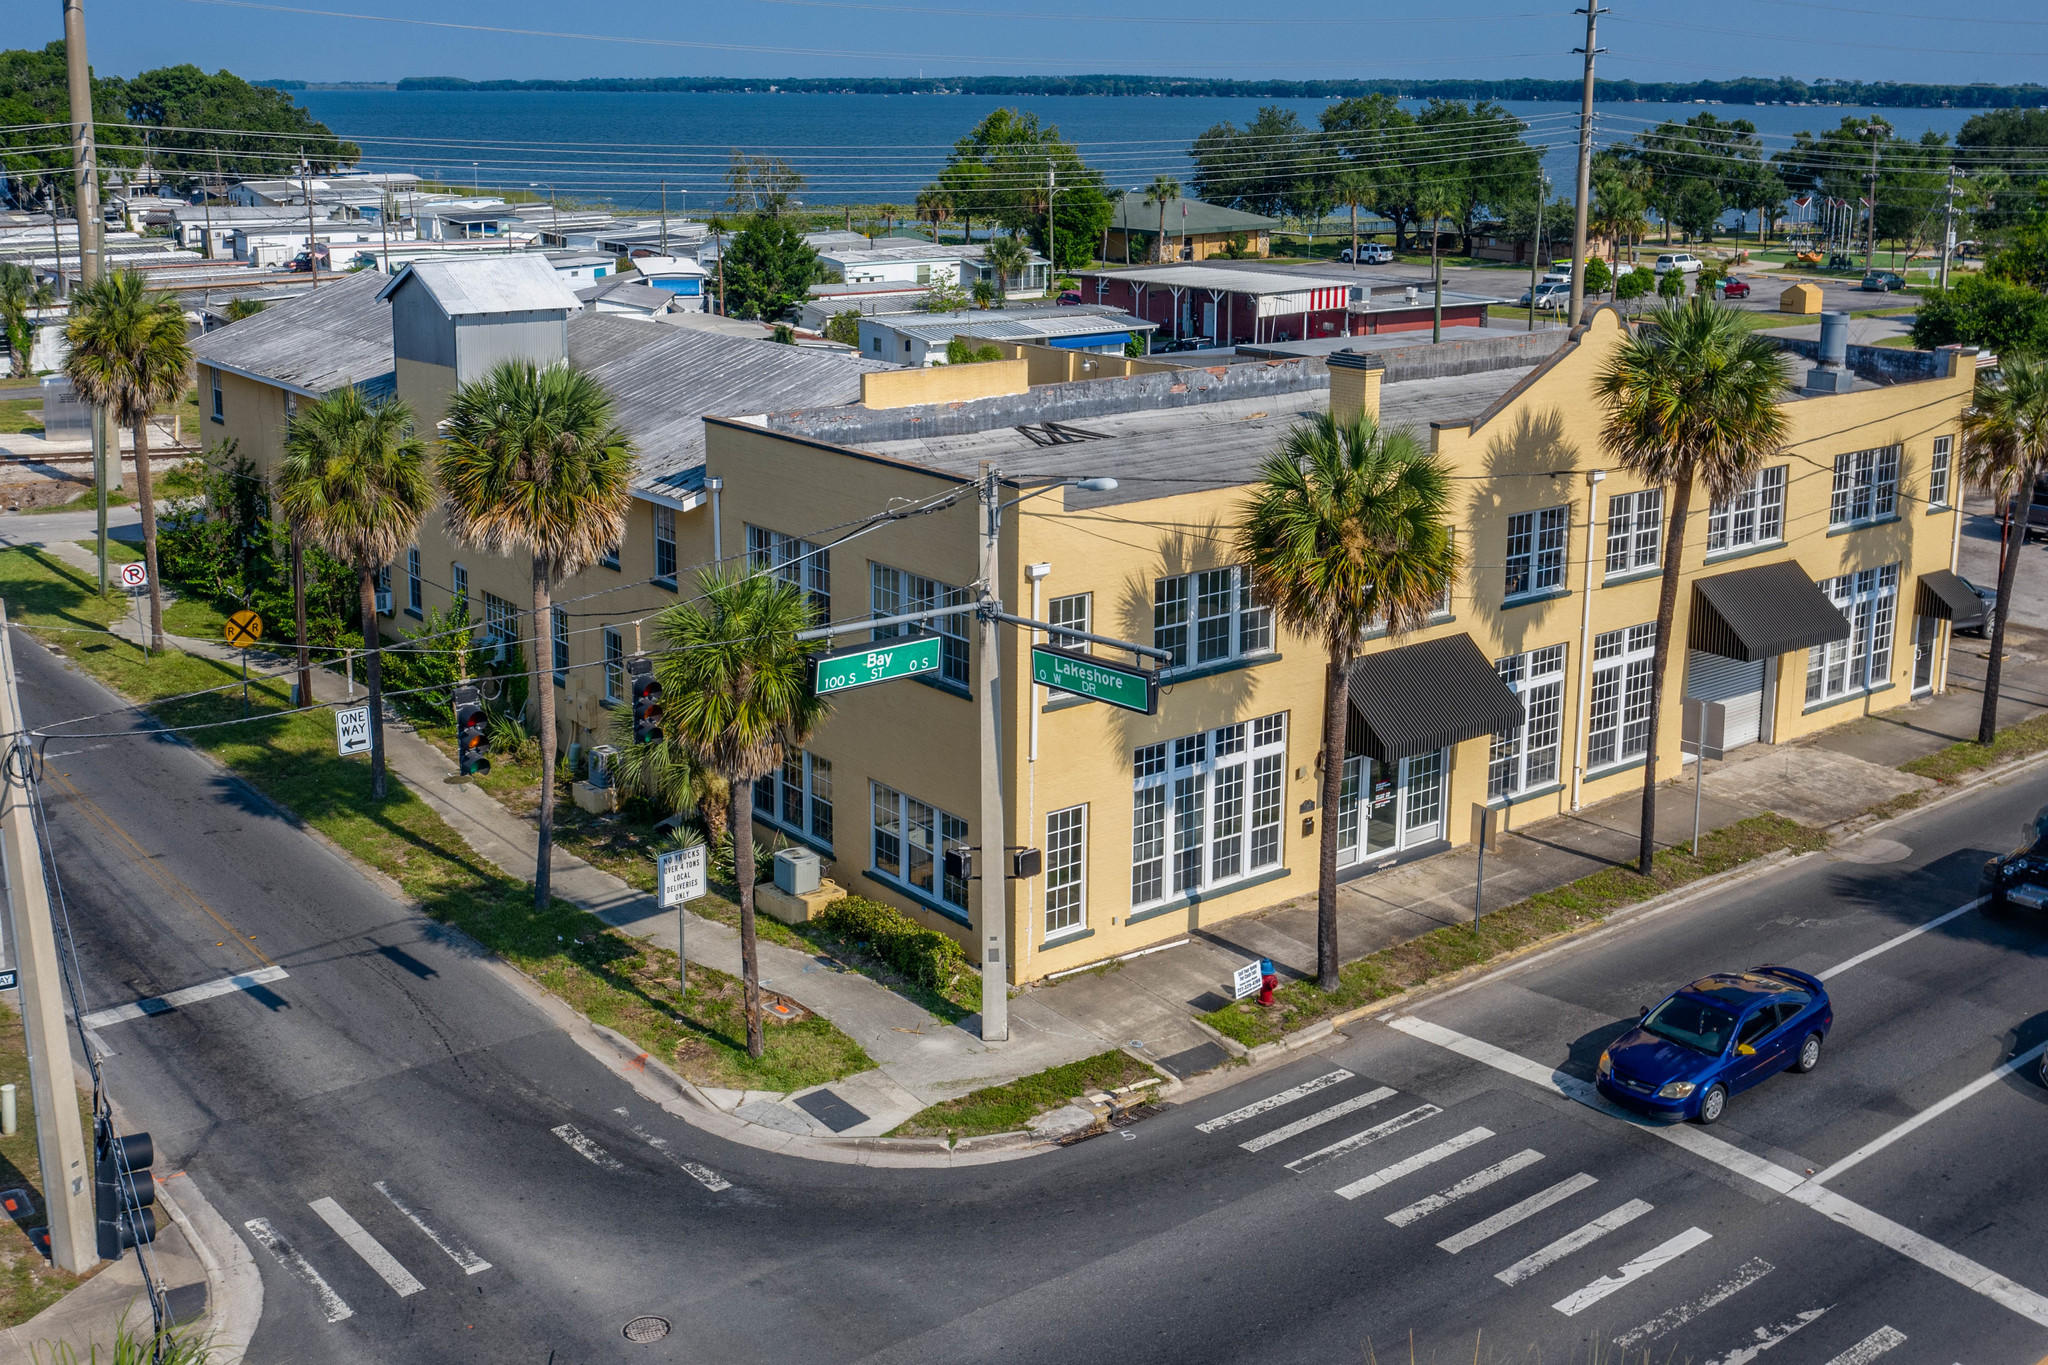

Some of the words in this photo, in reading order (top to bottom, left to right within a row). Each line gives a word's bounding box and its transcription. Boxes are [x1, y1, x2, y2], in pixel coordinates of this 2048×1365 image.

[129, 568, 139, 581] P
[228, 627, 235, 636] R
[252, 622, 259, 632] R
[866, 652, 893, 668] Bay
[825, 675, 845, 689] 100
[848, 673, 856, 684] S
[871, 668, 884, 679] ST
[921, 658, 928, 668] S
[1055, 658, 1123, 688] Lakeshore
[1053, 674, 1061, 684] W
[1082, 681, 1096, 694] DR
[341, 711, 365, 725] ONE
[341, 723, 365, 736] WAY
[675, 850, 699, 861] TRUCKS
[664, 865, 678, 874] OVER
[686, 859, 699, 868] TONS
[674, 872, 690, 882] LOCAL
[667, 879, 697, 893] DELIVERIES
[675, 891, 689, 900] ONLY
[0, 975, 10, 985] AY
[1120, 1130, 1137, 1141] 5
